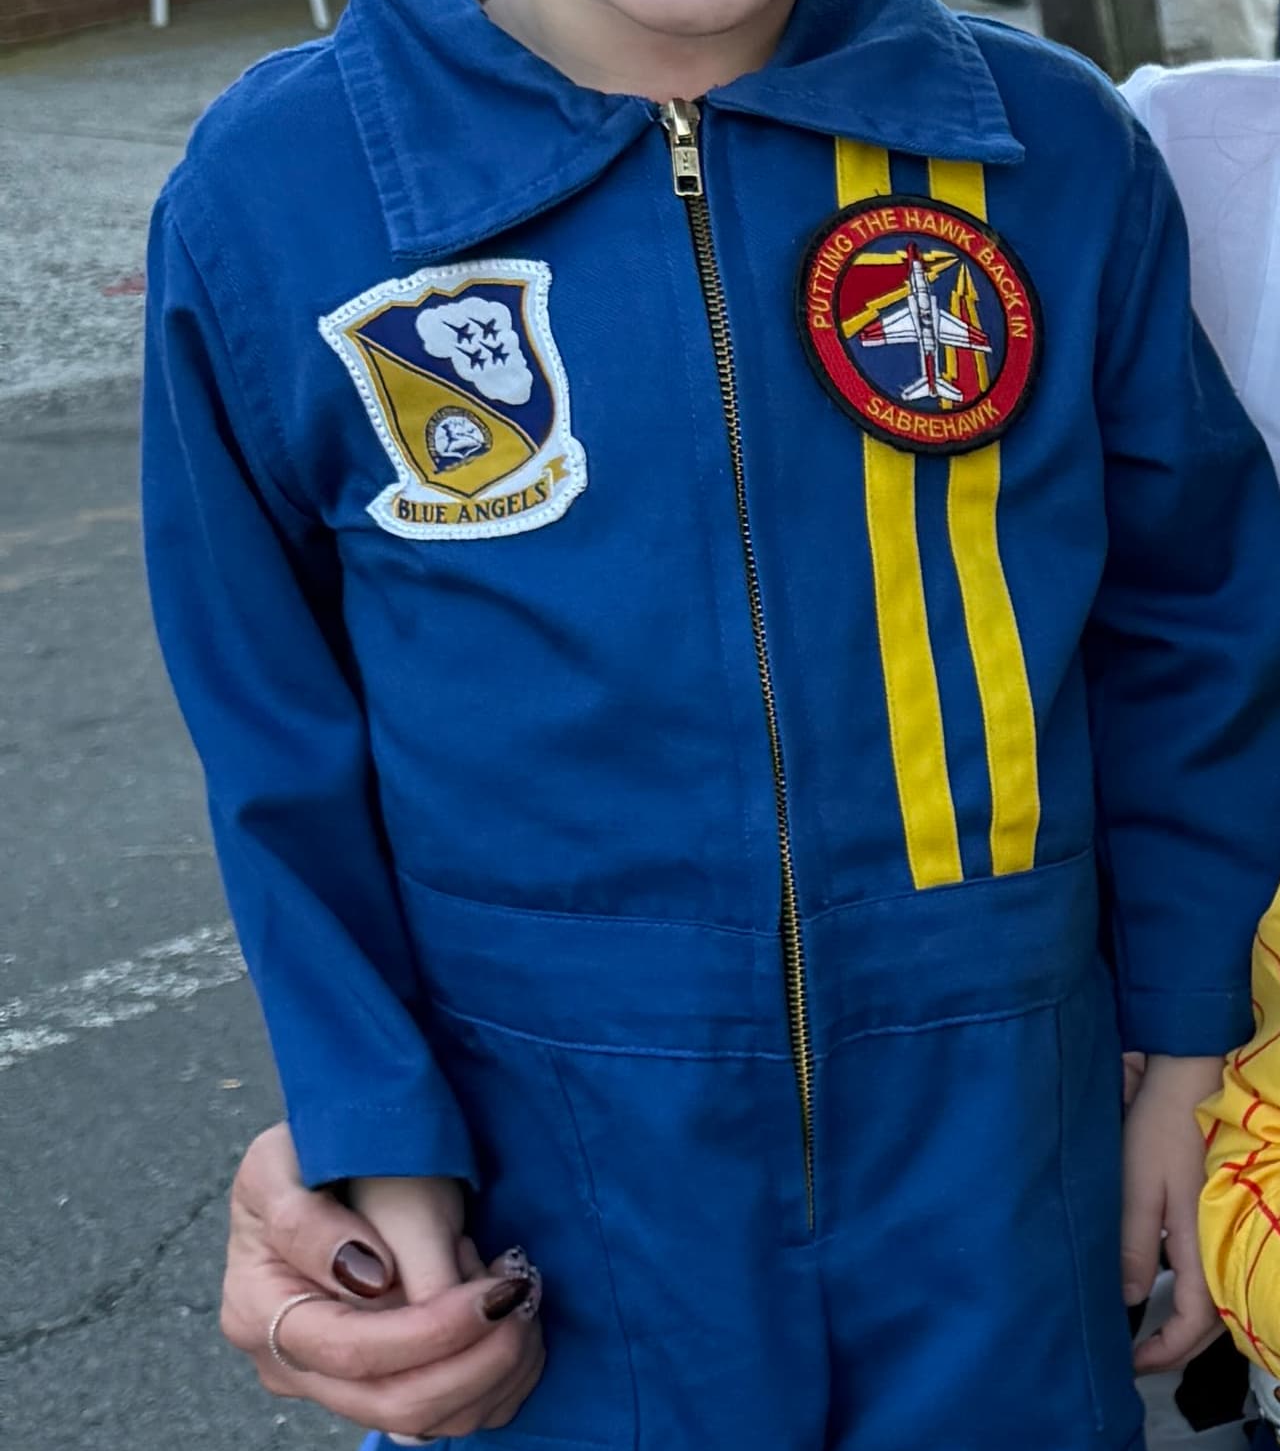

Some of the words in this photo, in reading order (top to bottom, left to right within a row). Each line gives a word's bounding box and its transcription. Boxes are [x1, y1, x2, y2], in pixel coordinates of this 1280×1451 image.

[812, 234, 854, 330] PUTTING
[851, 209, 899, 239] THE
[905, 210, 979, 250] HAWK
[977, 242, 1024, 312] BACK
[1010, 316, 1028, 339] IN
[866, 398, 1000, 438] SABREHAWK
[398, 497, 448, 524] BLUE
[456, 480, 547, 524] ANGELS
